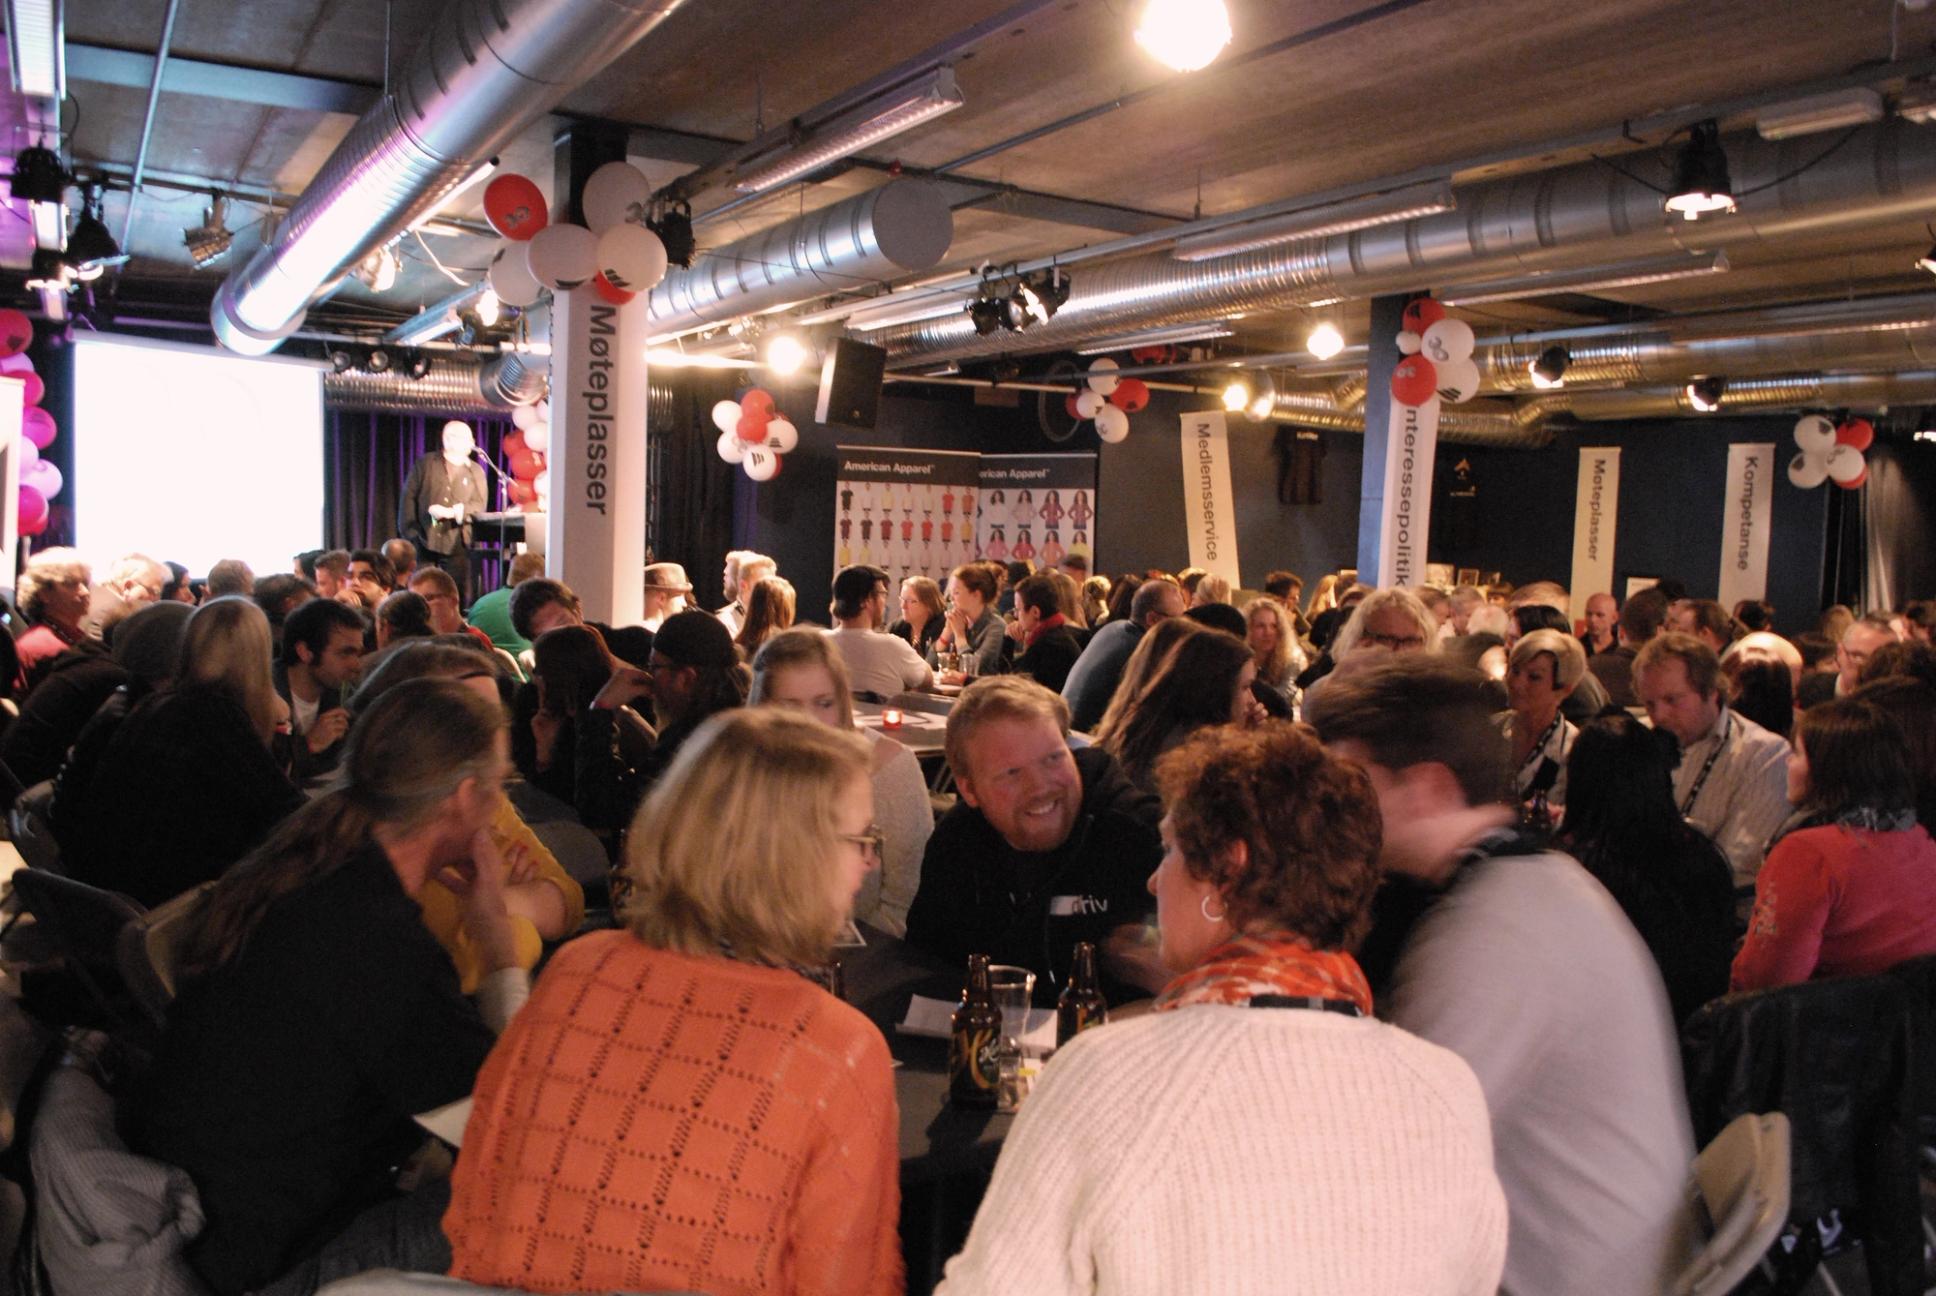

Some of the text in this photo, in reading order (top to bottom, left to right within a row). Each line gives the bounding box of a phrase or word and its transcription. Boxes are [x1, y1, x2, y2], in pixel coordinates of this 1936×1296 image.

[582, 304, 617, 516] Møteplasser
[844, 460, 891, 473] American
[979, 468, 1007, 479] erican
[1197, 423, 1220, 562] Medlemsservice
[1395, 408, 1419, 587] nteressepolitik
[1737, 455, 1759, 571] Kompetanse
